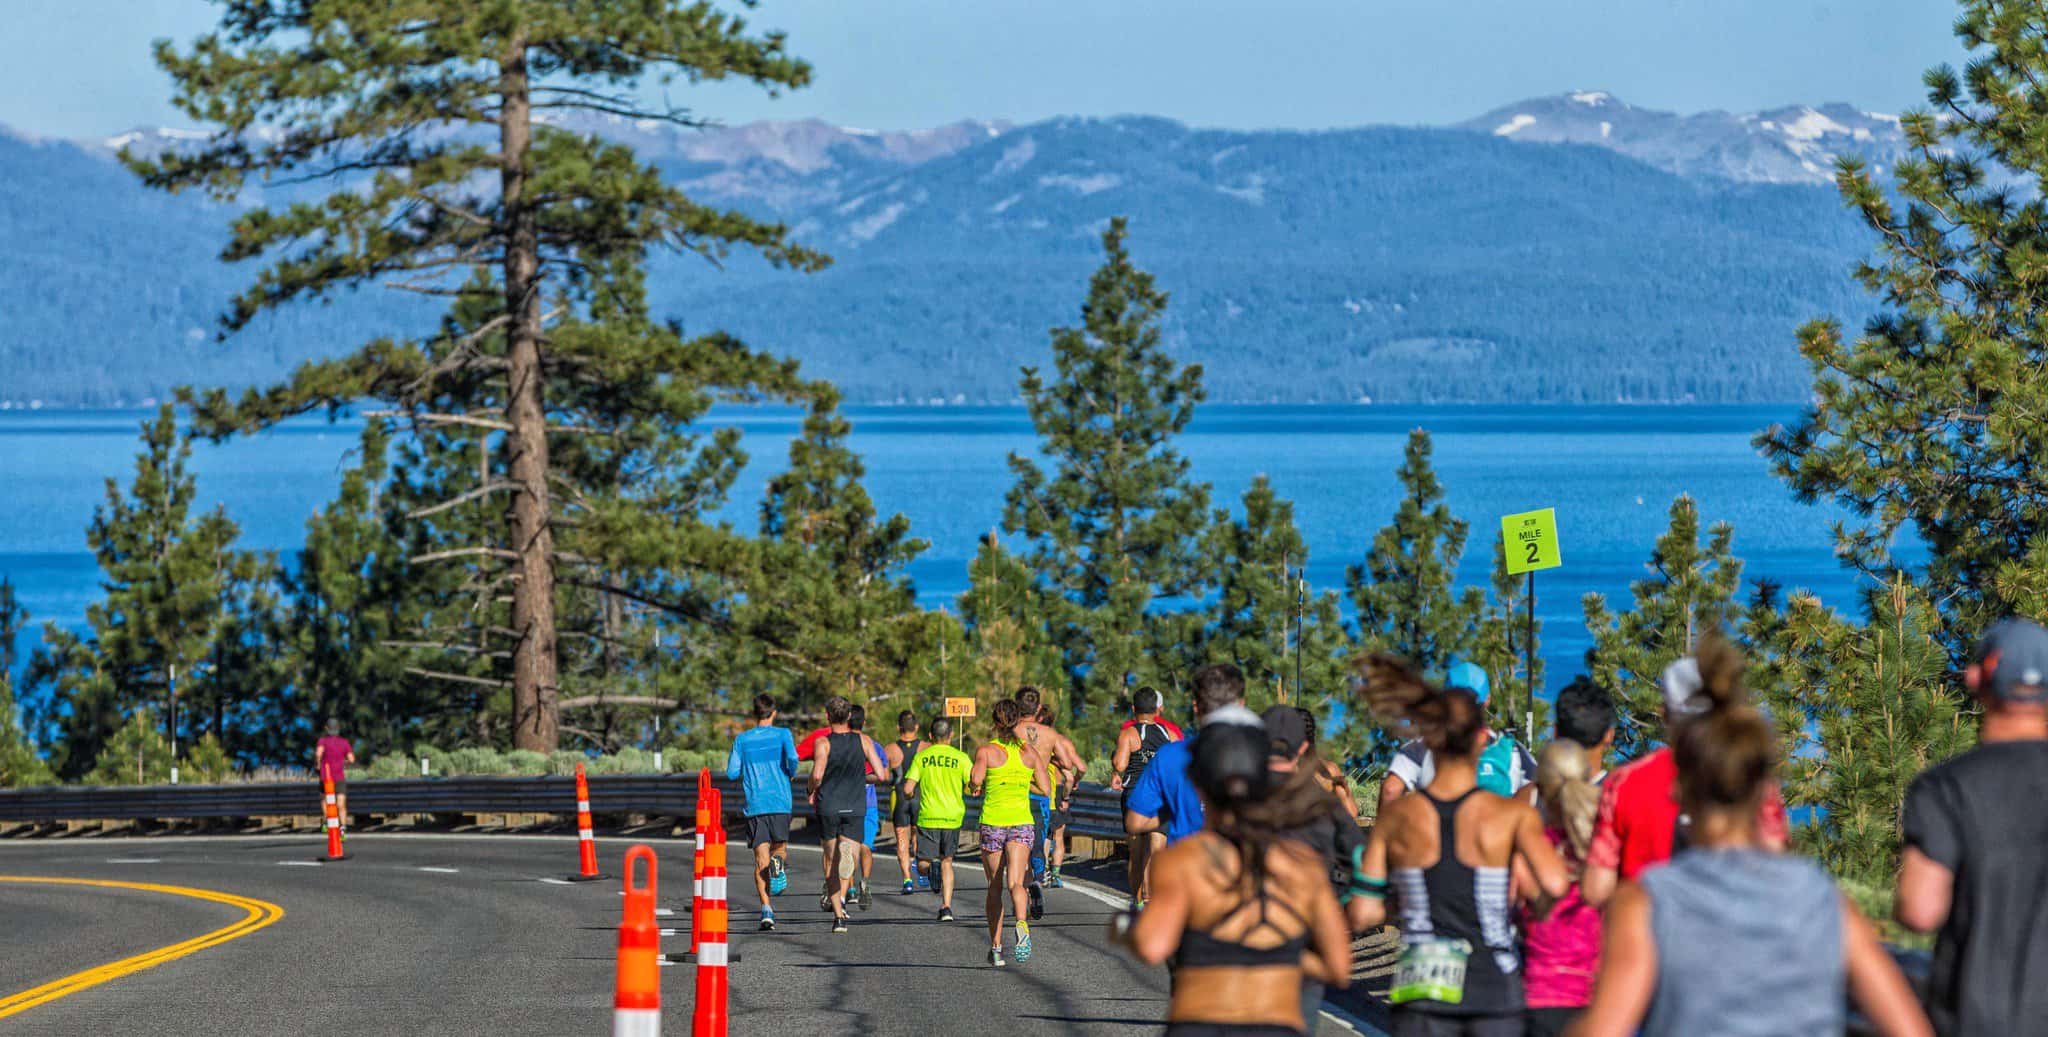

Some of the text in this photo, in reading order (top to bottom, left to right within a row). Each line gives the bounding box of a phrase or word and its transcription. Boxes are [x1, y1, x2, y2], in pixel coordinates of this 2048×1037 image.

[1519, 529, 1542, 540] MILE
[1526, 543, 1540, 563] 2
[922, 755, 959, 768] PACER
